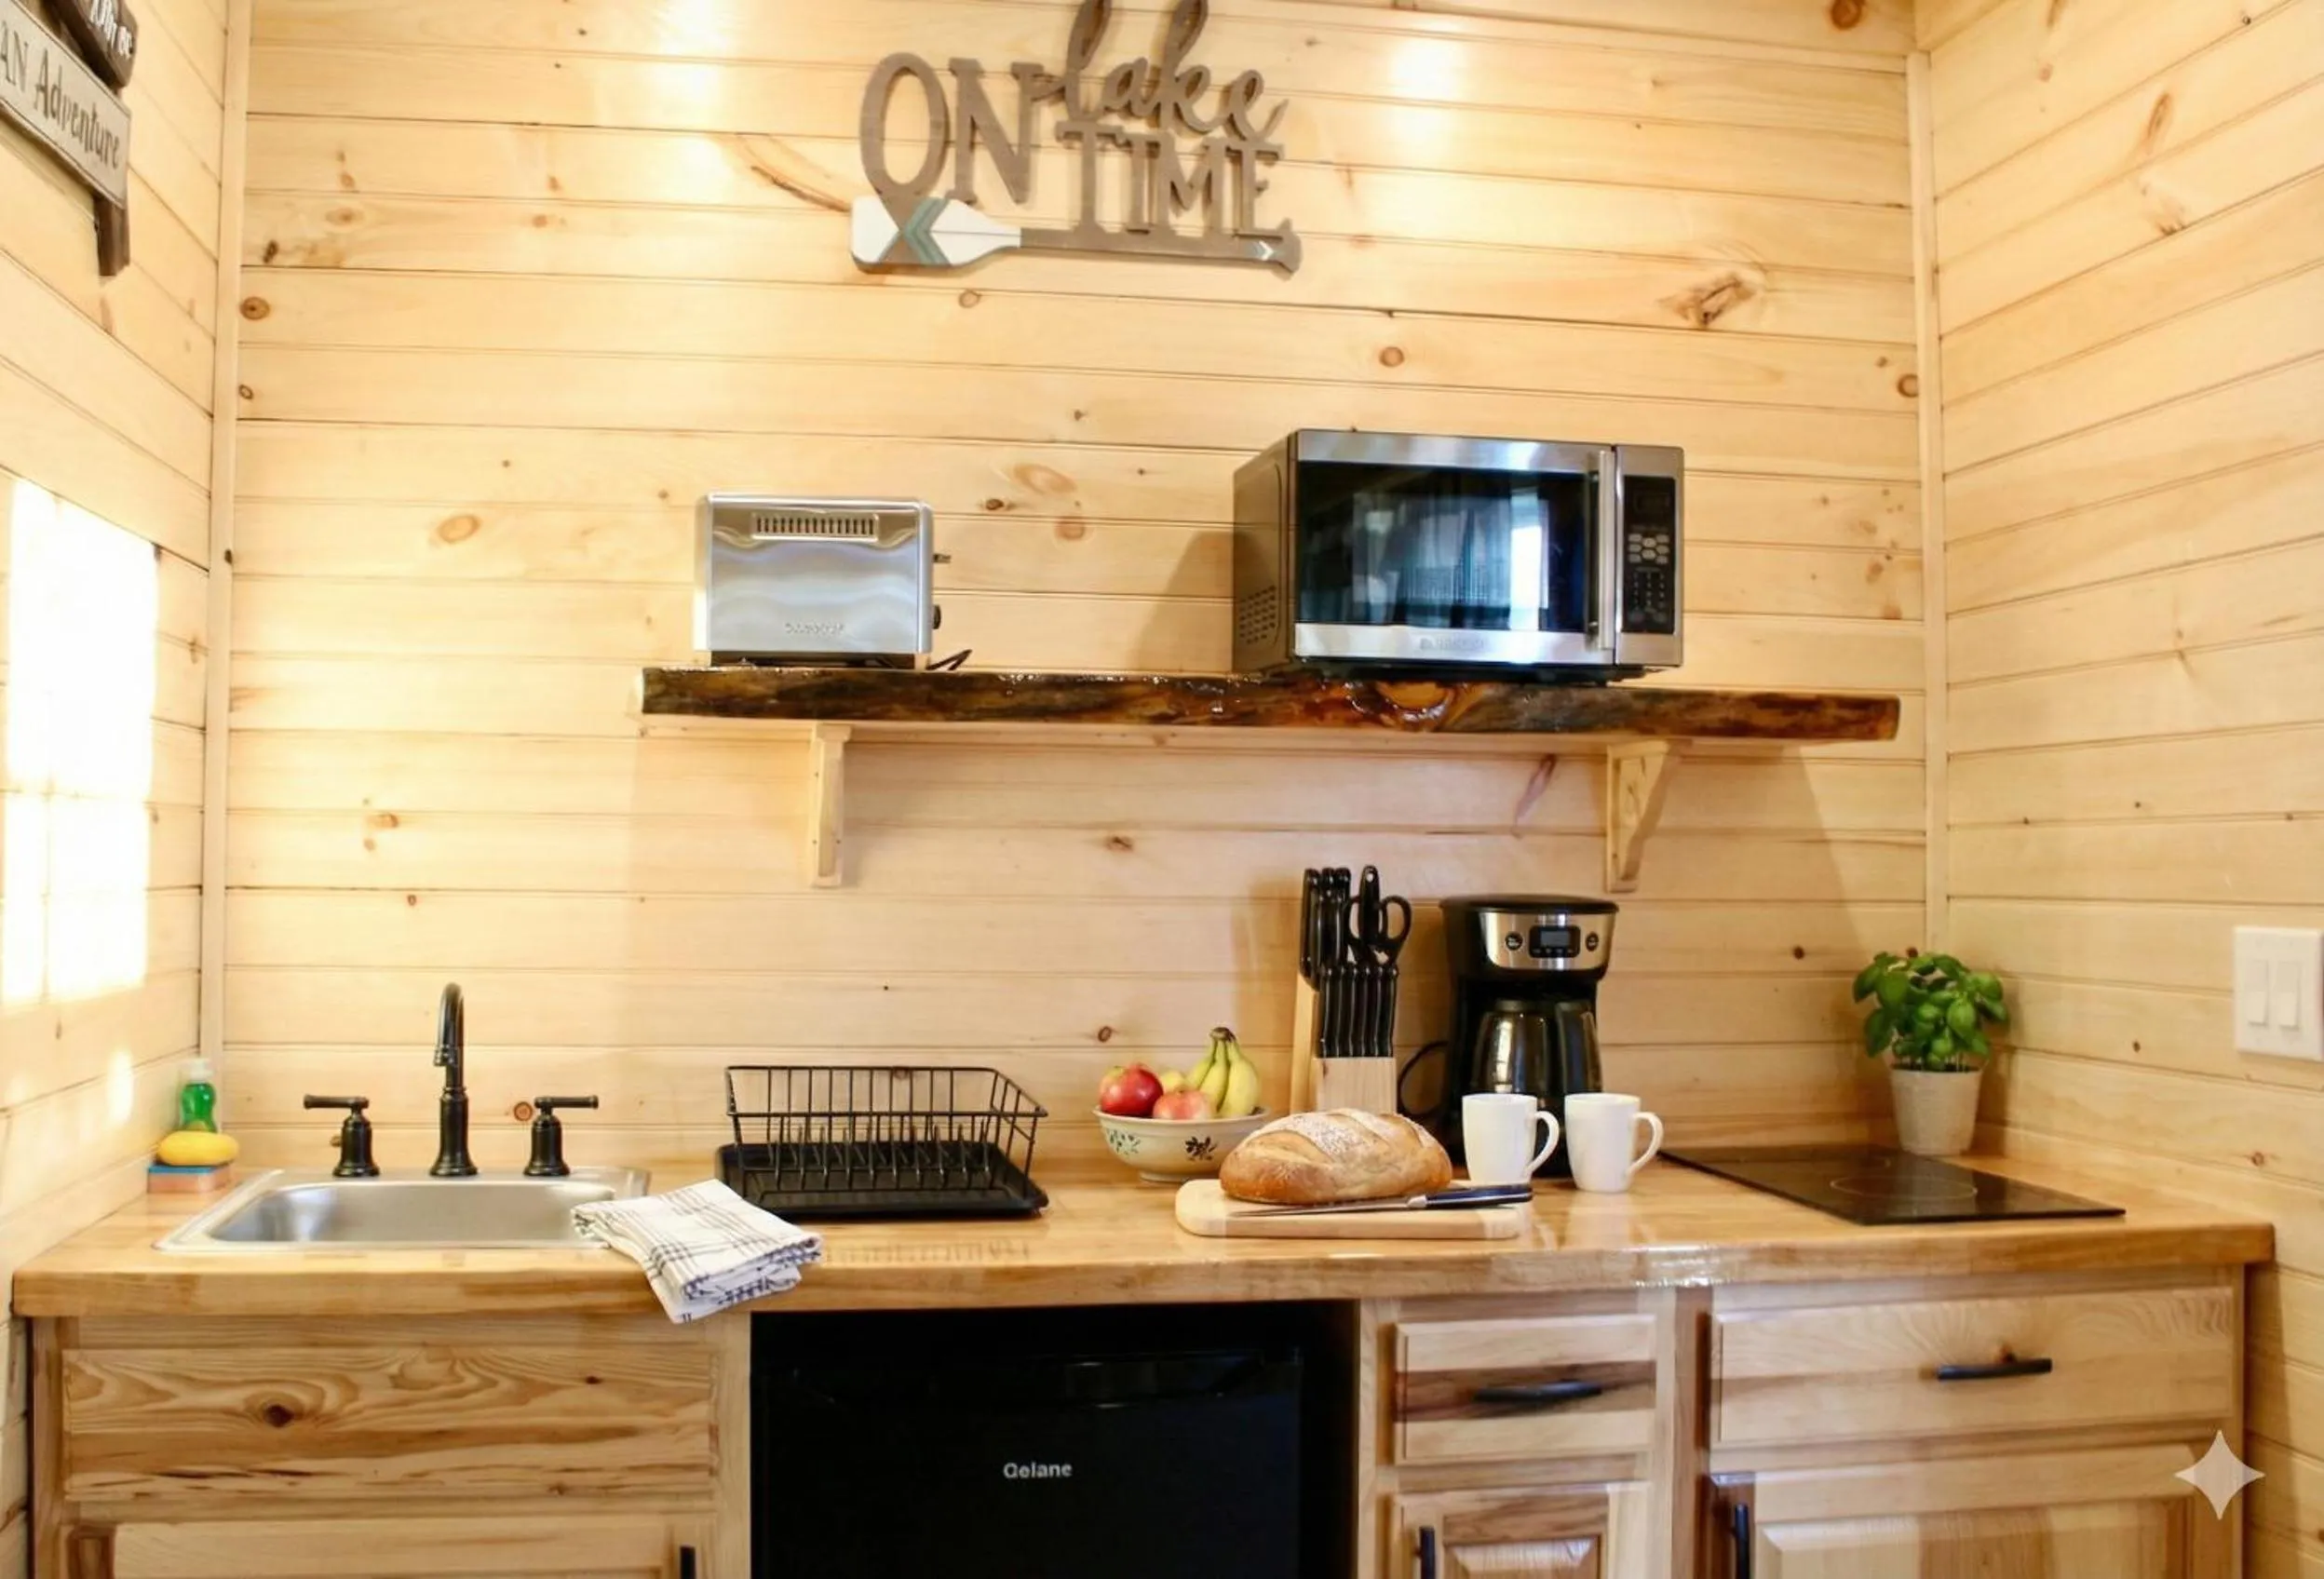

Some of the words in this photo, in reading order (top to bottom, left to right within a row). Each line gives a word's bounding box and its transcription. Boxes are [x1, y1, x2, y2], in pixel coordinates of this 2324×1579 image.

[34, 47, 120, 169] Adventure
[860, 52, 1043, 204] ON
[1041, 0, 1290, 141] lake
[1055, 121, 1295, 238] TIME
